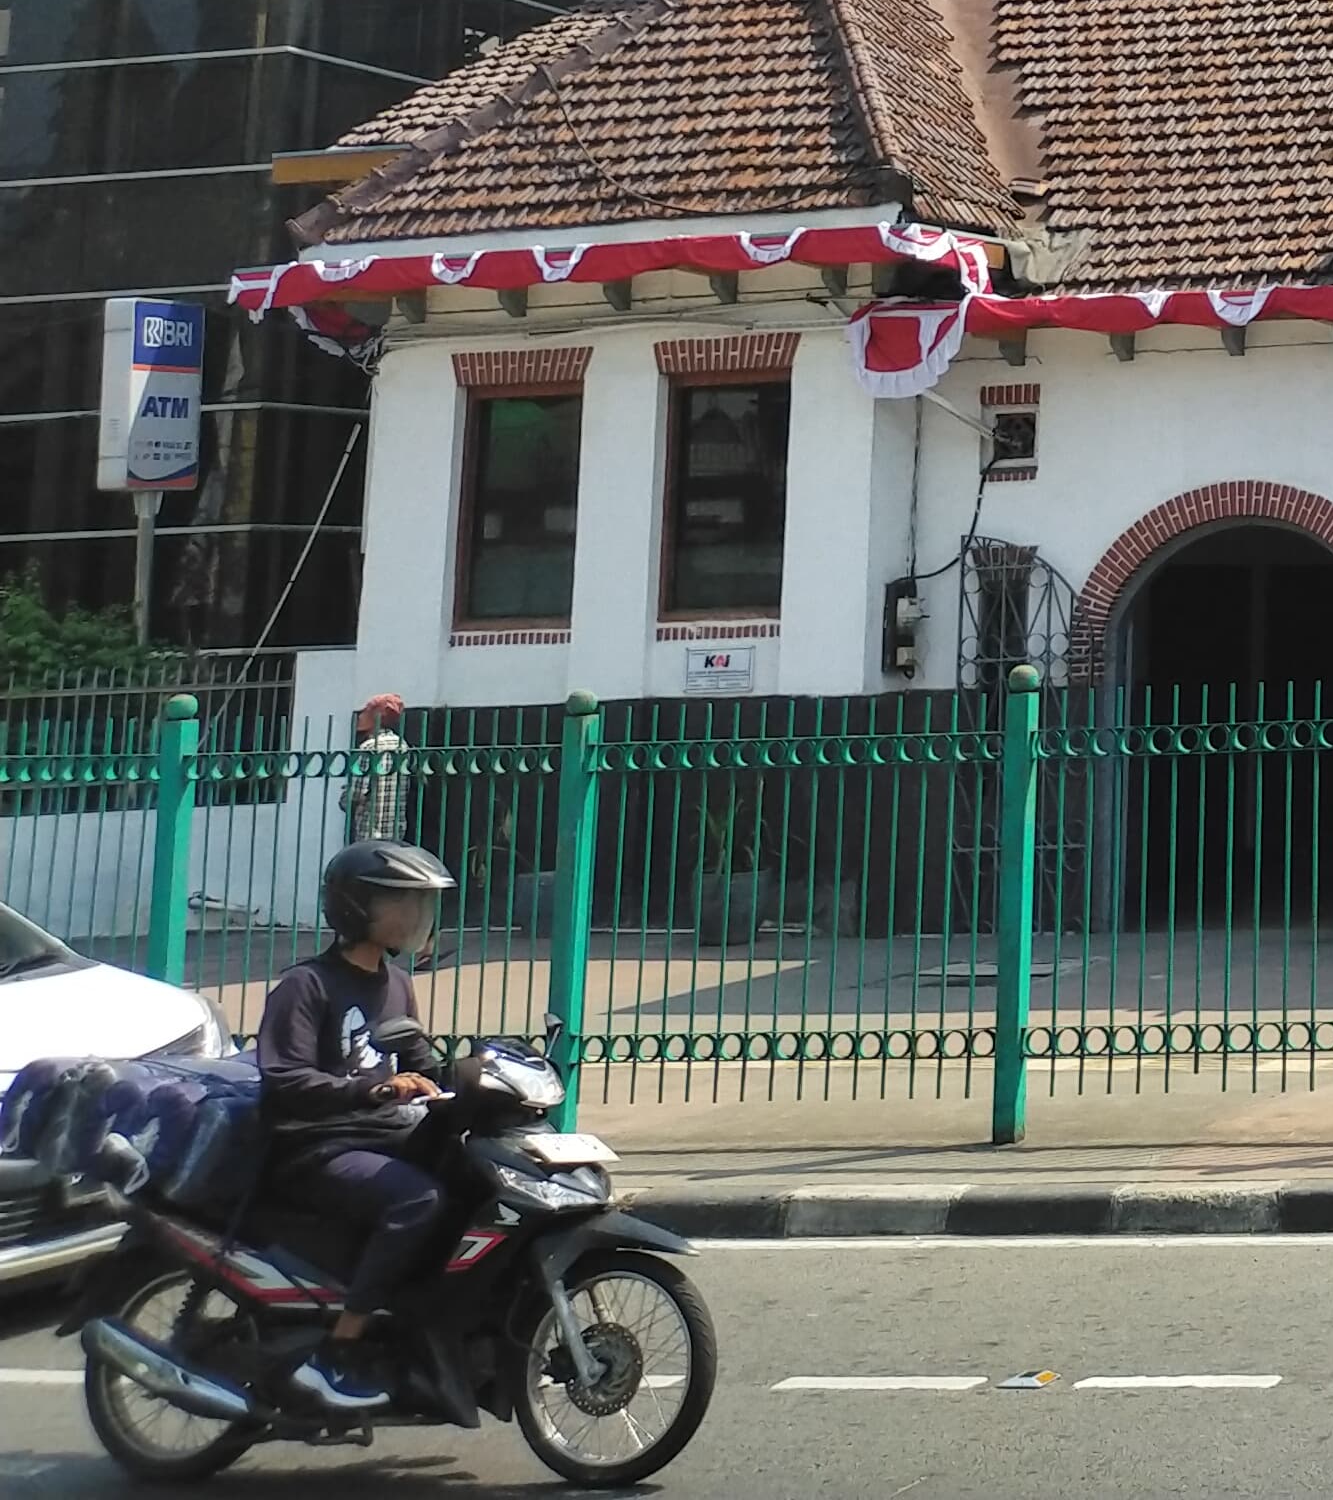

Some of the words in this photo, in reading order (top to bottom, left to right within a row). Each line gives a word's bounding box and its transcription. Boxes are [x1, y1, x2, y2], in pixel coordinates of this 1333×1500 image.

[163, 320, 193, 348] BRI
[141, 396, 189, 419] ATM
[704, 654, 731, 669] KAI
